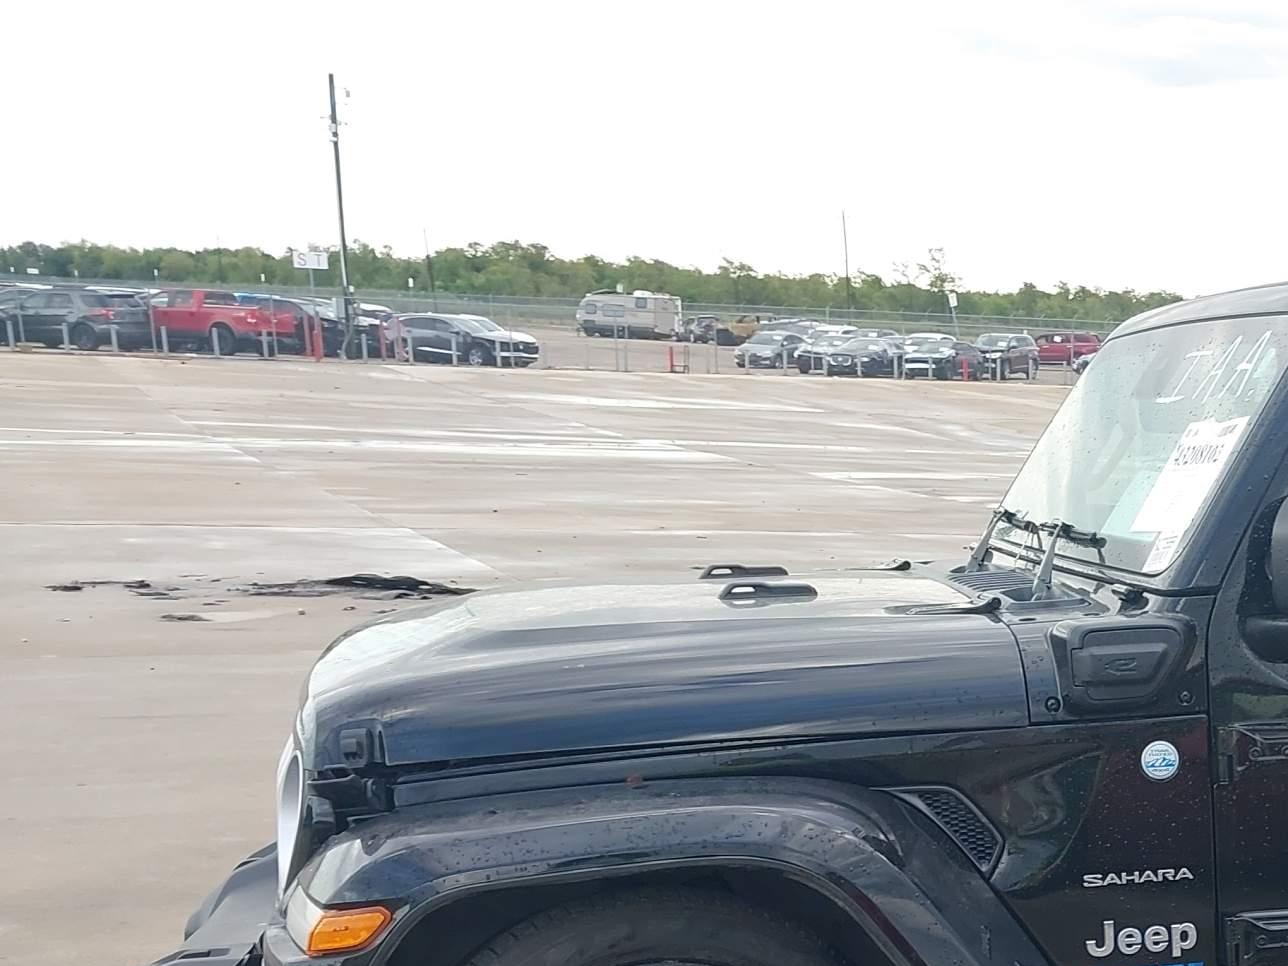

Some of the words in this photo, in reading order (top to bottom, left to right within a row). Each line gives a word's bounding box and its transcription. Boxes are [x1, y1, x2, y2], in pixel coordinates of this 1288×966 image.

[297, 253, 307, 267] S
[1155, 330, 1273, 404] IAA
[1082, 867, 1194, 888] SAHARA
[1085, 920, 1198, 958] Jeep
